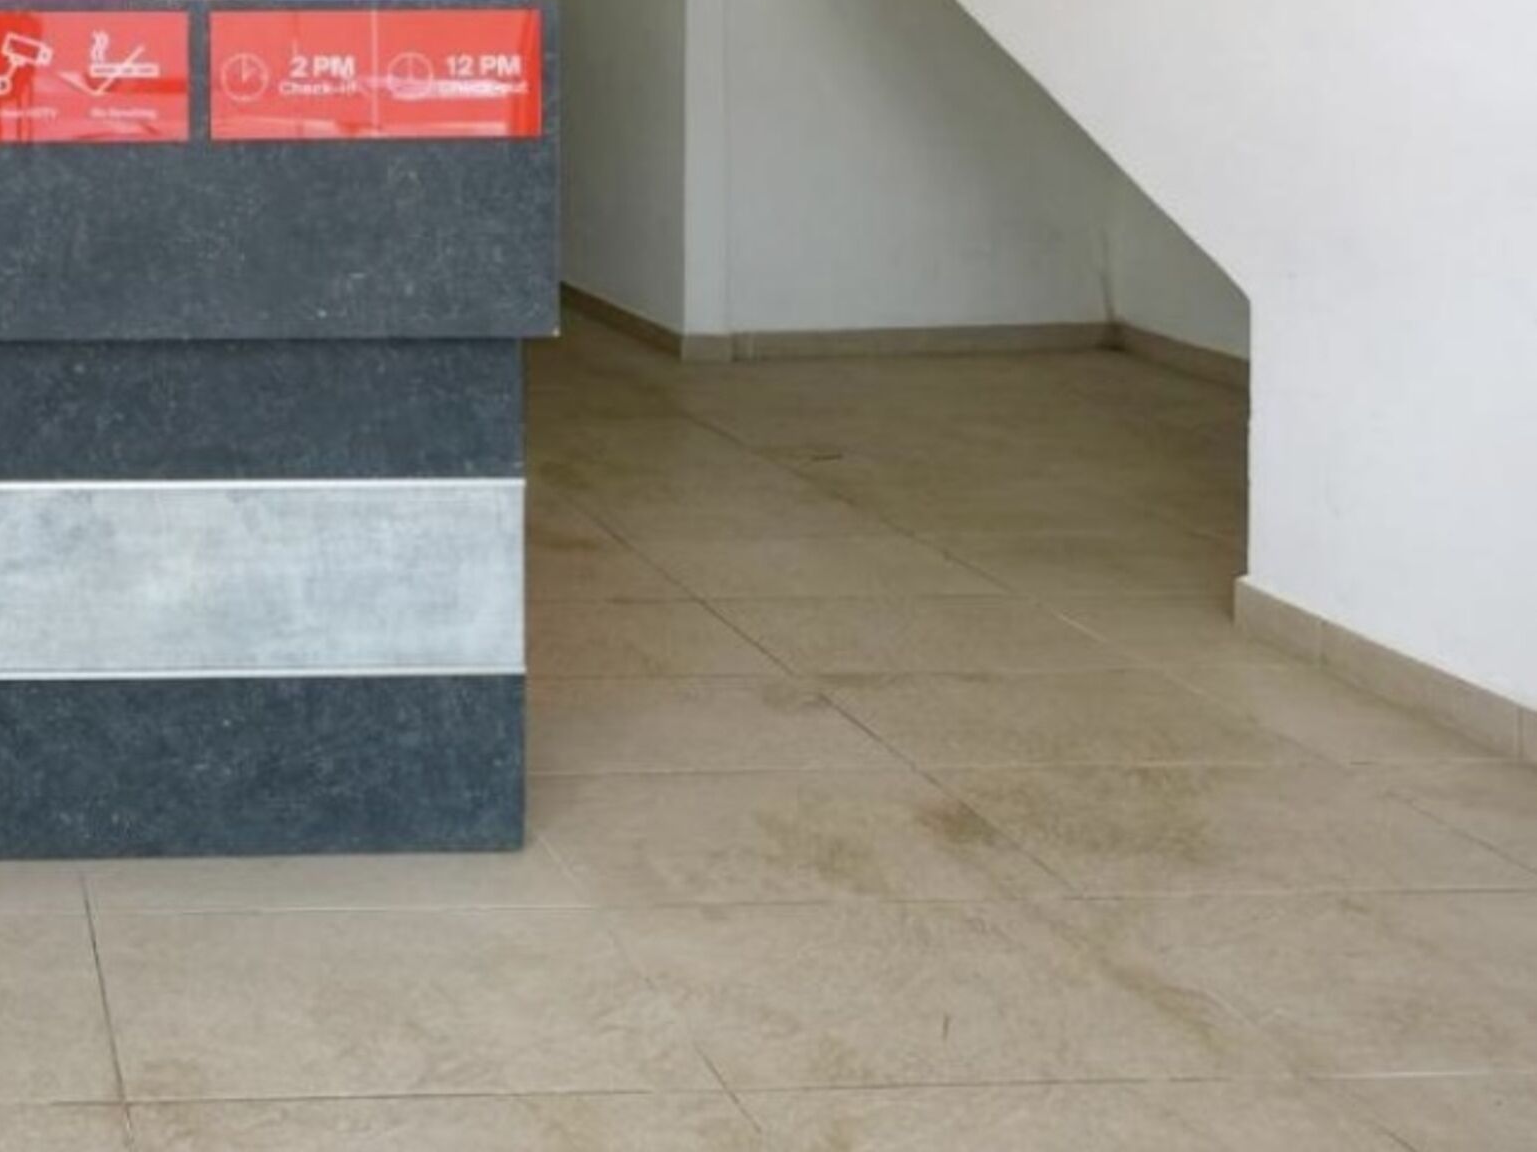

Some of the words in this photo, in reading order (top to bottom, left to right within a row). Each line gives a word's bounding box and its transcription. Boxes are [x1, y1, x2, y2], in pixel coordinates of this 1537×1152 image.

[289, 55, 308, 78] 2
[312, 55, 356, 79] PM
[447, 55, 473, 76] 12
[480, 55, 521, 77] PM
